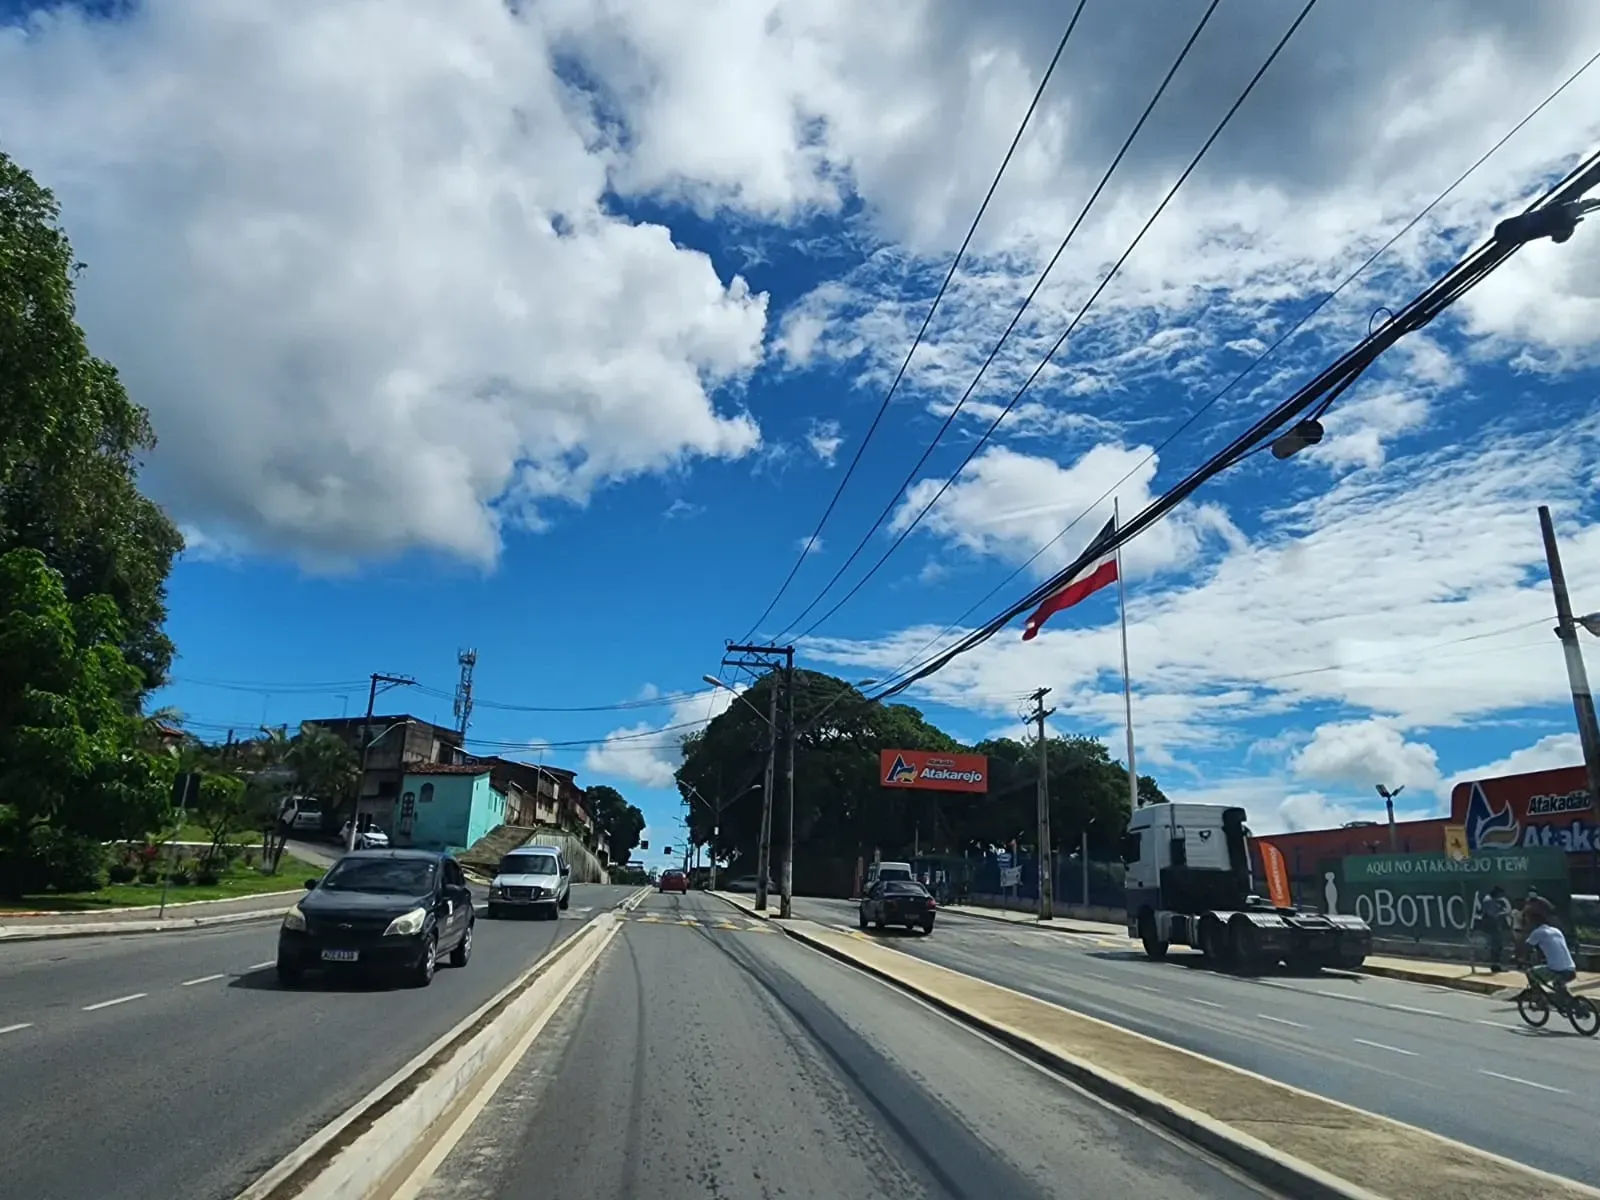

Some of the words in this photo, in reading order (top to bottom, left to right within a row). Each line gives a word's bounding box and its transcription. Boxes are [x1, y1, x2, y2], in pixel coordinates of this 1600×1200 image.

[920, 767, 982, 783] Atakarejo
[1366, 860, 1392, 876] AQUI
[1394, 859, 1412, 873] NO
[1496, 856, 1530, 872] TEM
